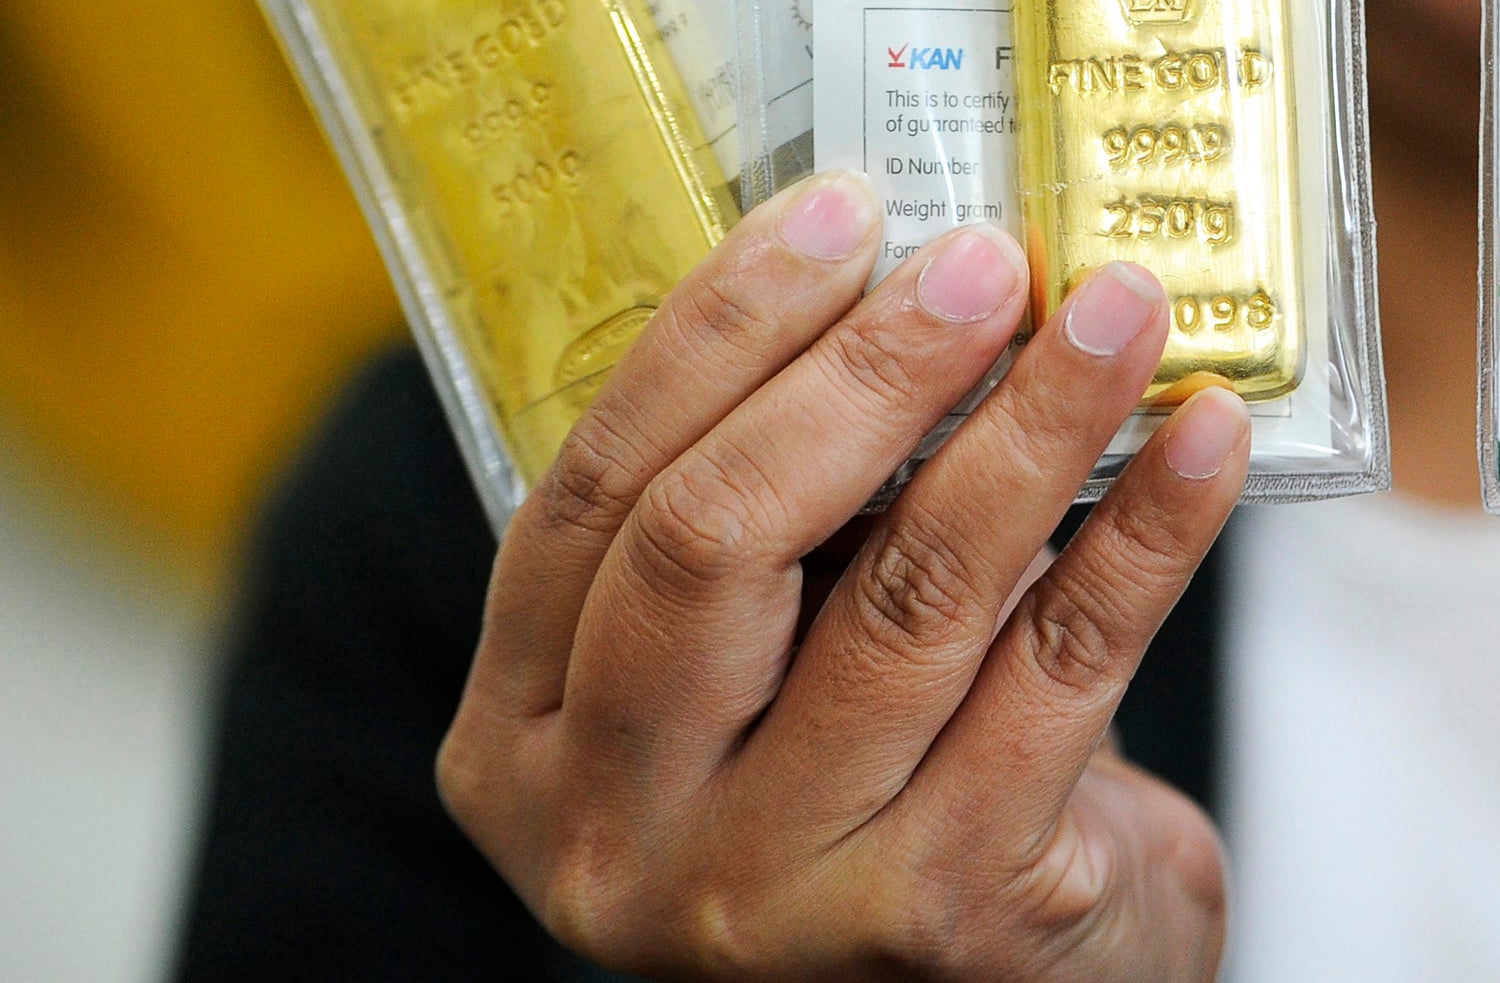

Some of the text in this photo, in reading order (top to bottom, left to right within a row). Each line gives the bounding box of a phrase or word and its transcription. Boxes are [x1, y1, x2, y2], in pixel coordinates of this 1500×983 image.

[910, 48, 963, 70] KAN
[1050, 54, 1145, 97] FINE
[1154, 49, 1273, 91] GOLD
[886, 90, 1010, 114] This is to certify
[886, 114, 904, 133] of
[1102, 125, 1225, 165] 999.9
[886, 158, 903, 175] ID
[886, 200, 1003, 222] Weight gram)
